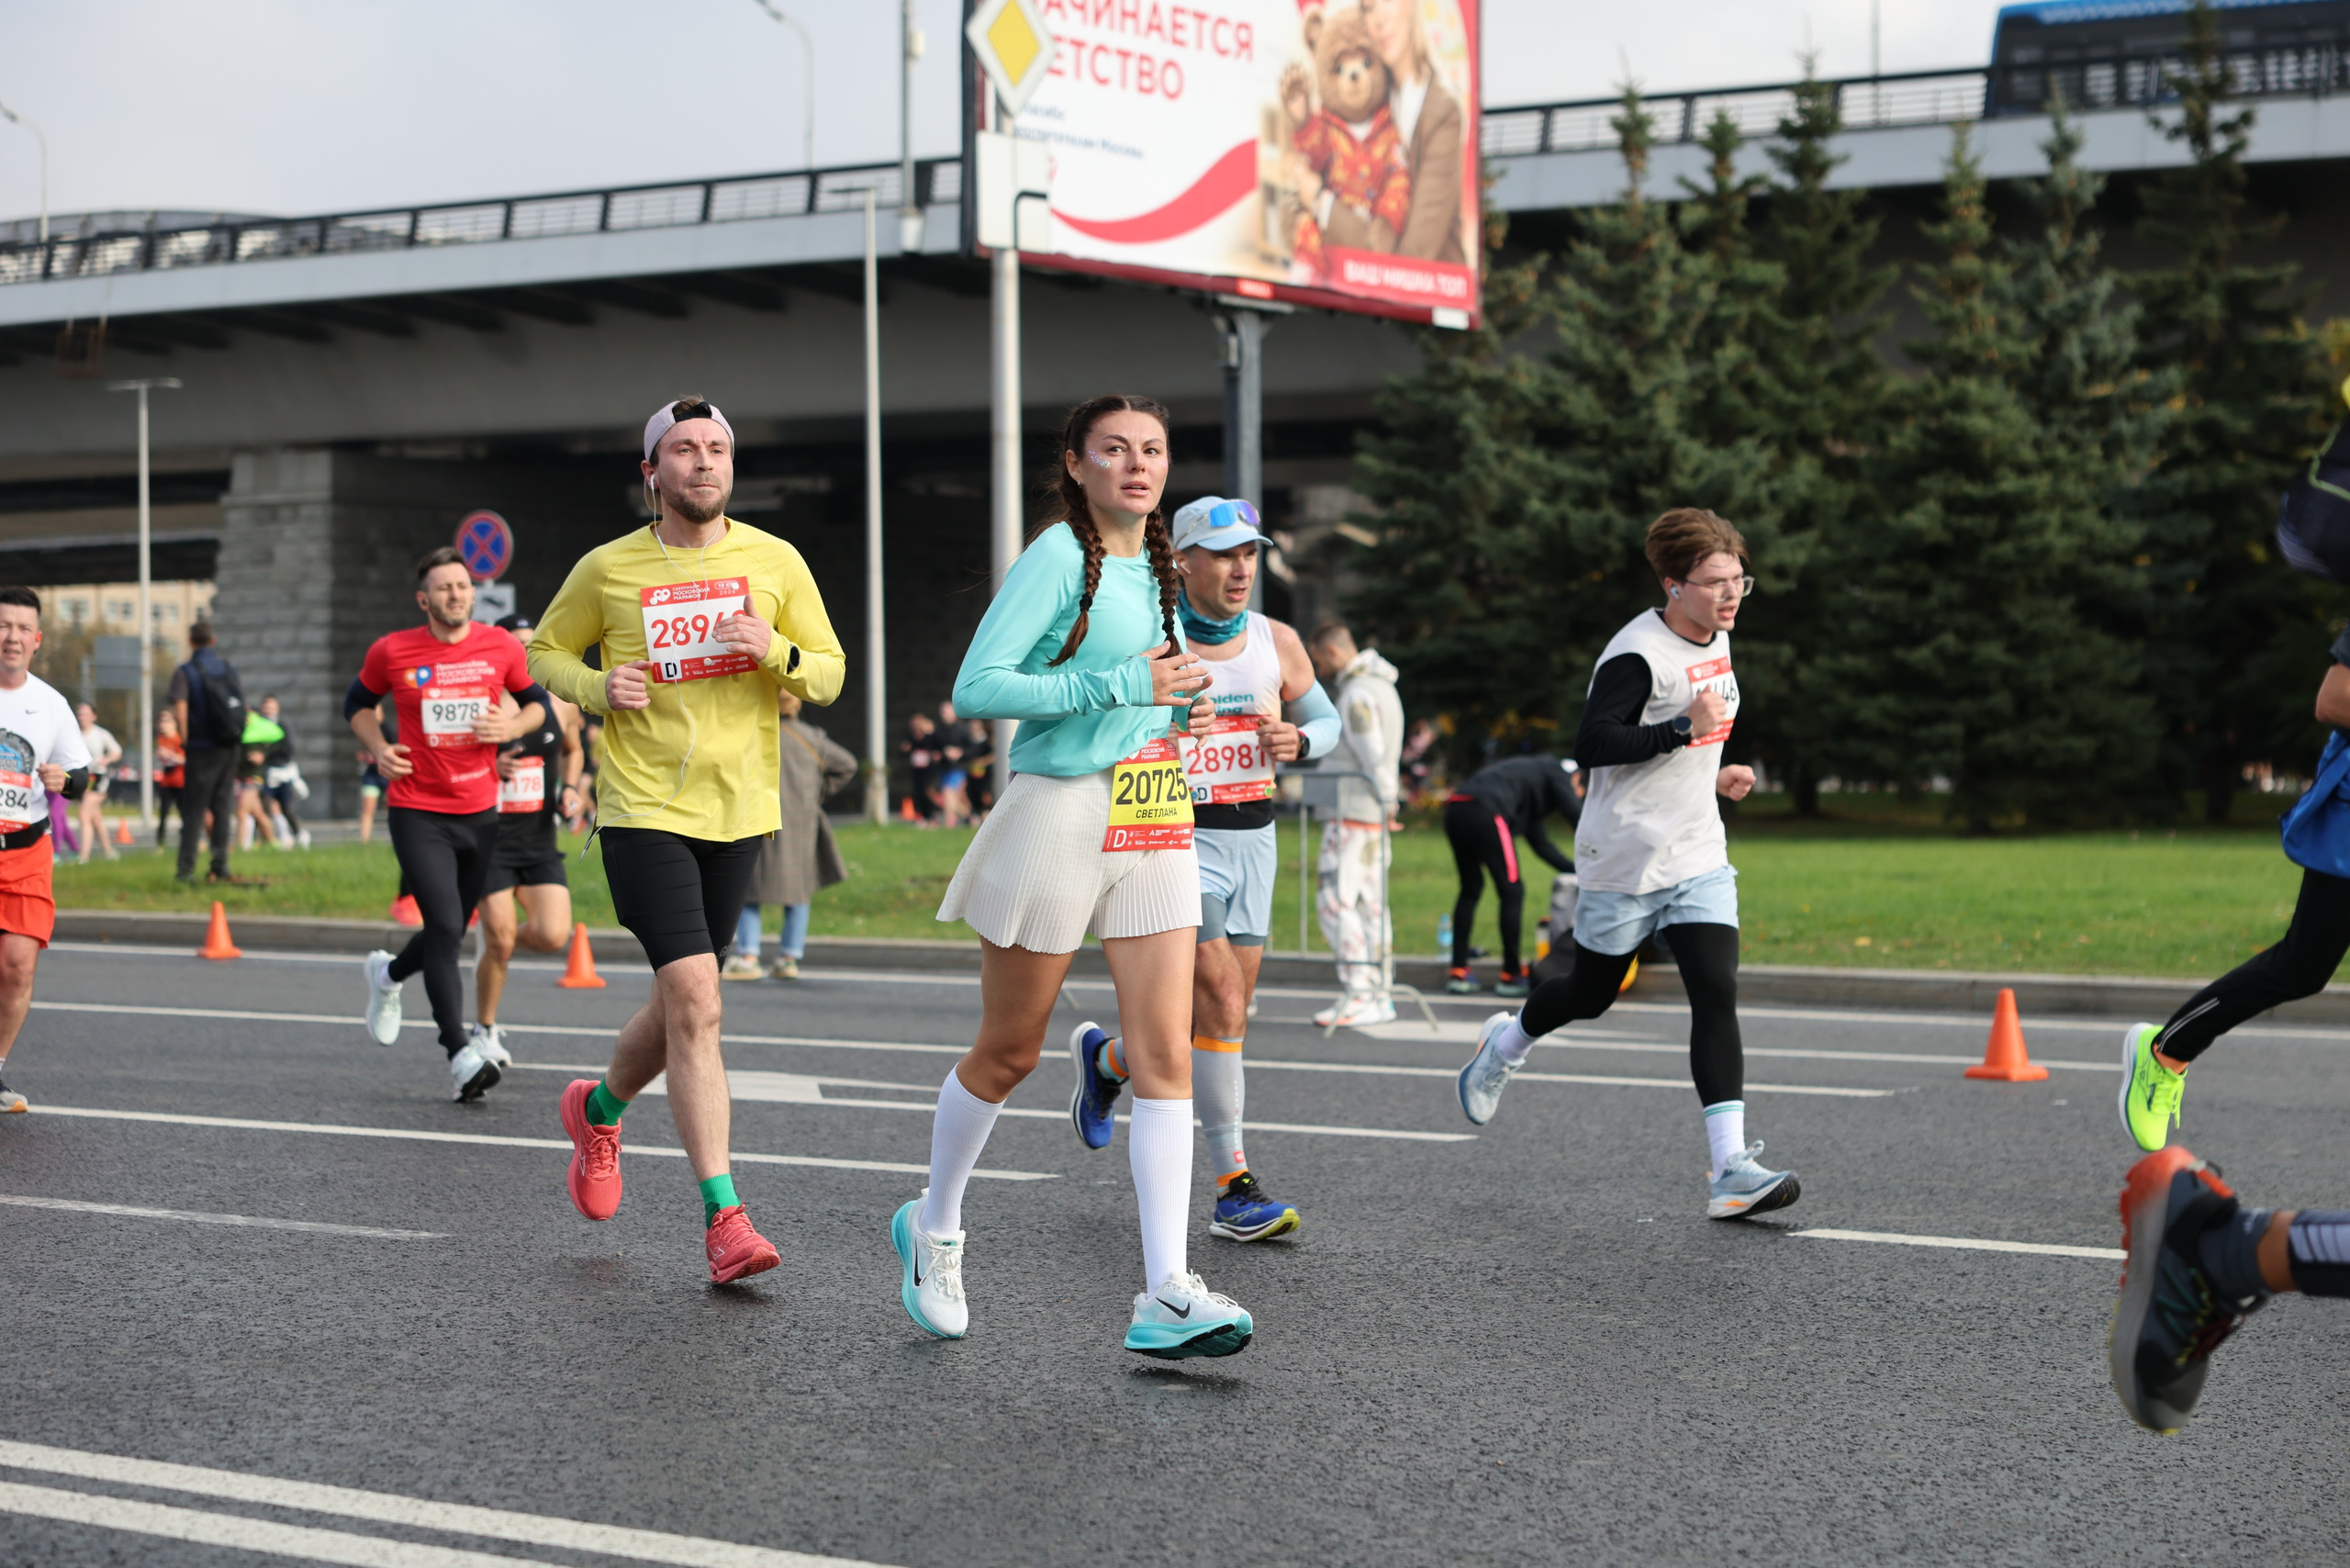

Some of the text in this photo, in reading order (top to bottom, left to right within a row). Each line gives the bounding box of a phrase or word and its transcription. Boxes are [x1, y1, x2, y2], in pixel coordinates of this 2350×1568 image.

[1035, 0, 1254, 62] АЧИНАЕТСЯ
[651, 610, 745, 649] 289
[666, 662, 677, 678] D
[1208, 693, 1254, 705] olden
[432, 702, 480, 722] 9878
[1186, 744, 1267, 775] 28981
[1115, 767, 1188, 805] 20725
[1197, 787, 1207, 801] D
[1136, 807, 1178, 819] СВЕТЛАНА
[1113, 829, 1127, 848] D
